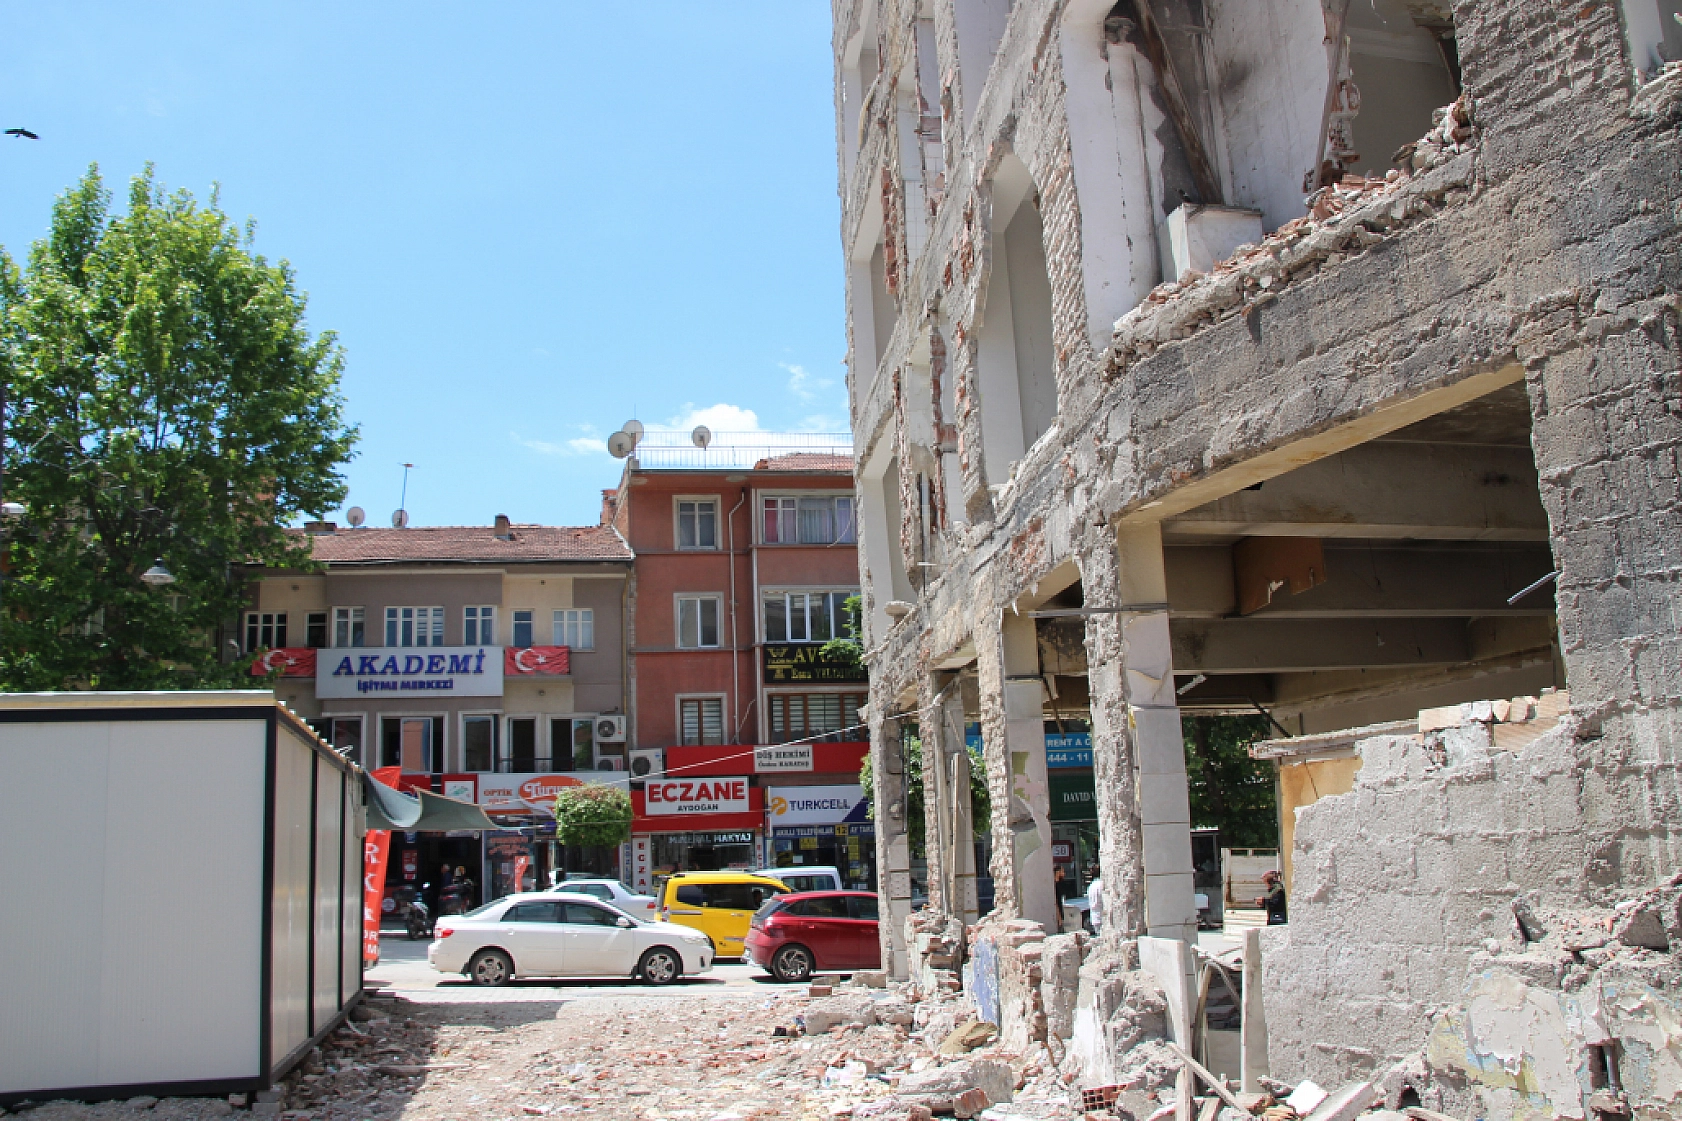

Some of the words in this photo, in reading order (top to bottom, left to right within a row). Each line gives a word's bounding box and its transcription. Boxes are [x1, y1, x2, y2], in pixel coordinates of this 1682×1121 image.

[333, 649, 485, 675] AKADEMİ
[357, 679, 398, 694] İŞİTME
[400, 677, 454, 691] MERKEZİ
[1047, 739, 1073, 748] RENT
[1075, 738, 1083, 747] A
[775, 748, 810, 759] HEKİMİ
[1047, 753, 1068, 763] 444
[483, 787, 513, 797] OPTİK
[648, 781, 746, 803] ECZANE
[789, 798, 851, 811] TURKCELL
